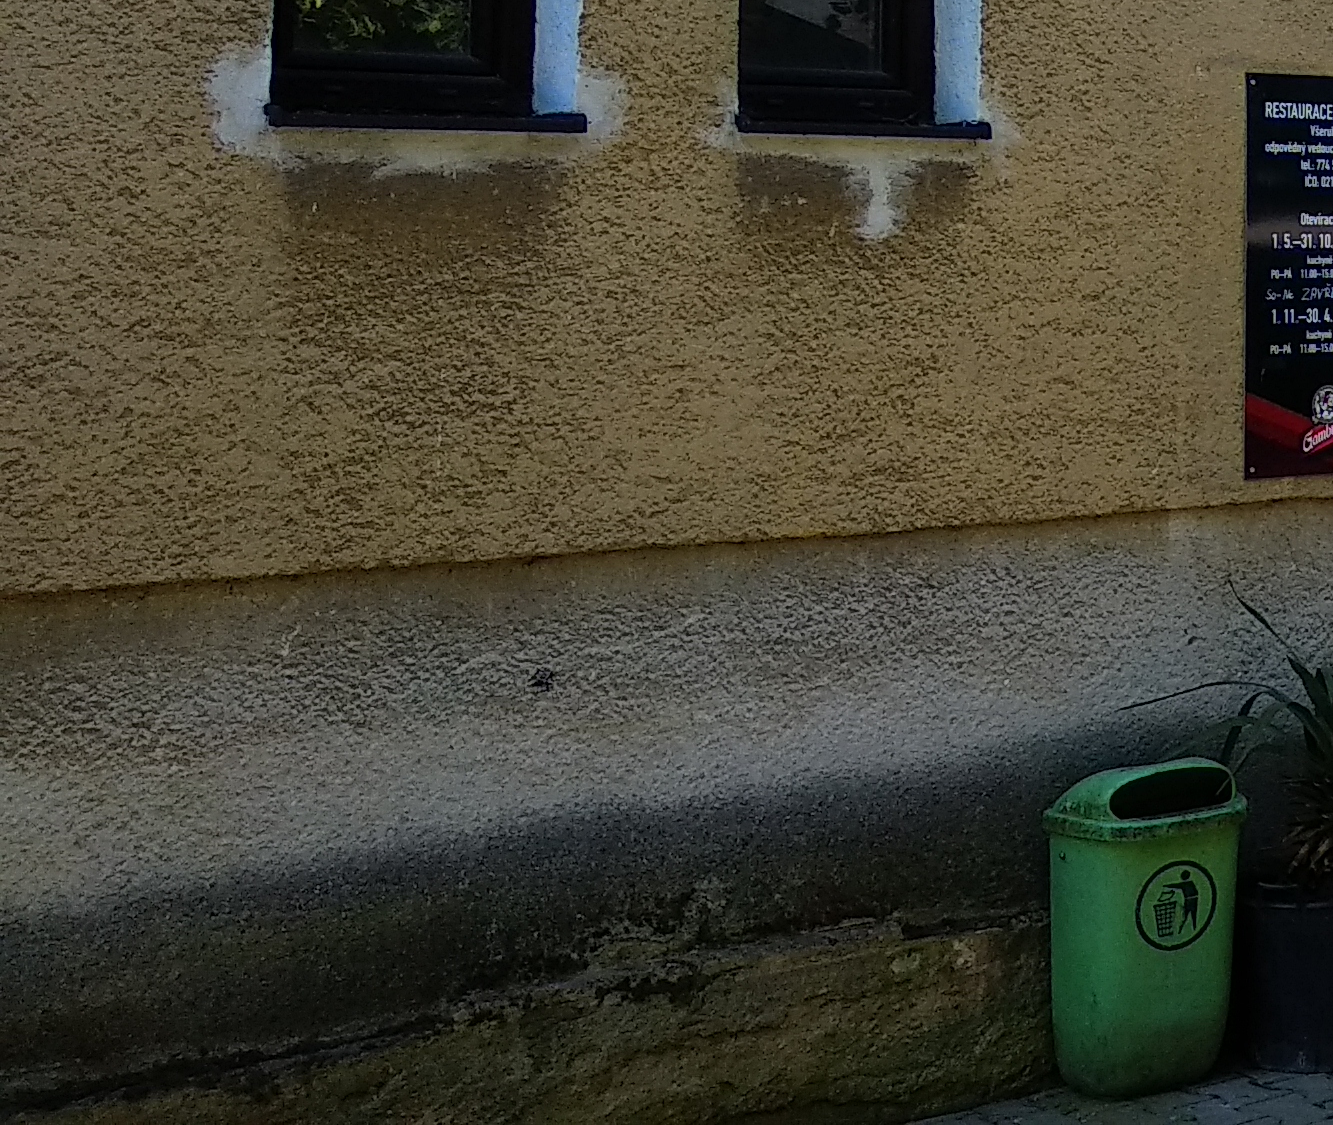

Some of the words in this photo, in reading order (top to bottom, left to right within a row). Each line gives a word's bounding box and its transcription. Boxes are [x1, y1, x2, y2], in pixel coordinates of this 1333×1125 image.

[1264, 101, 1333, 120] RESTAURACE
[1271, 233, 1282, 249] 1.
[1271, 308, 1282, 325] 1.
[1323, 307, 1333, 323] 4.
